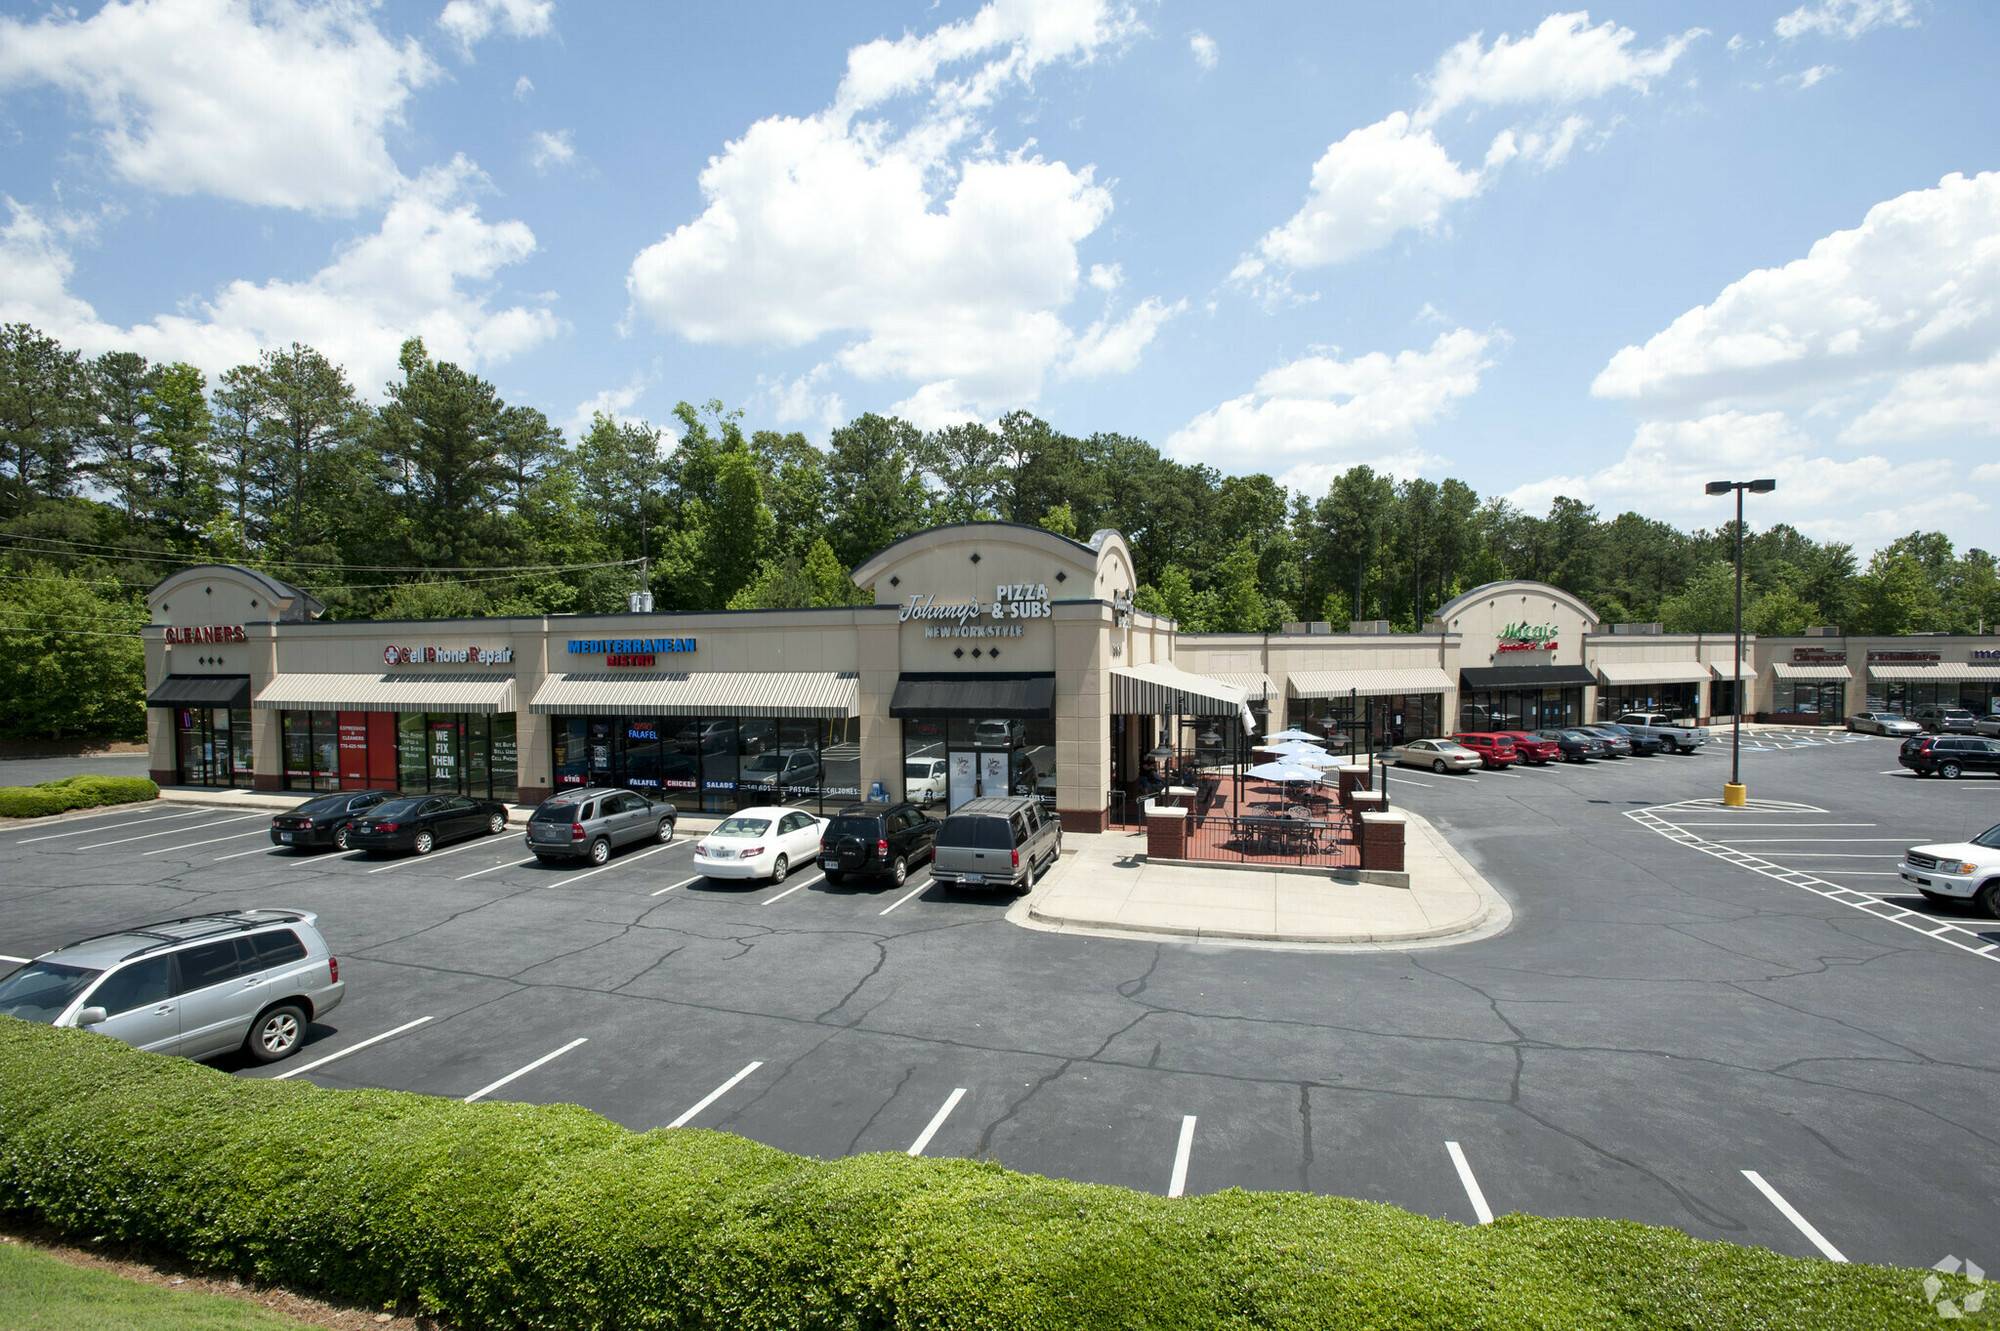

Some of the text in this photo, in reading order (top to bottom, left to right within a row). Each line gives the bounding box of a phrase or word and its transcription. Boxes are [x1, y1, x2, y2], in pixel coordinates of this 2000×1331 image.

[997, 583, 1049, 601] PIZZA
[899, 593, 981, 626] Johnny's
[991, 601, 1052, 619] & SUBS
[165, 624, 246, 645] CLEANERS
[924, 624, 1024, 639] NEW YORK STYLE
[567, 638, 697, 653] MEDITERRANEAN
[400, 646, 513, 667] Cell Phone Repair
[607, 655, 655, 667] BISTRO
[435, 731, 448, 742] WE
[628, 730, 658, 740] FALAFEL
[436, 743, 449, 754] FIX
[431, 755, 454, 766] THEM
[435, 768, 450, 778] ALL
[629, 778, 658, 787] FALAFEL
[667, 780, 696, 788] CHICKEN
[706, 781, 734, 789] SALADS
[826, 787, 858, 795] CALZONES
